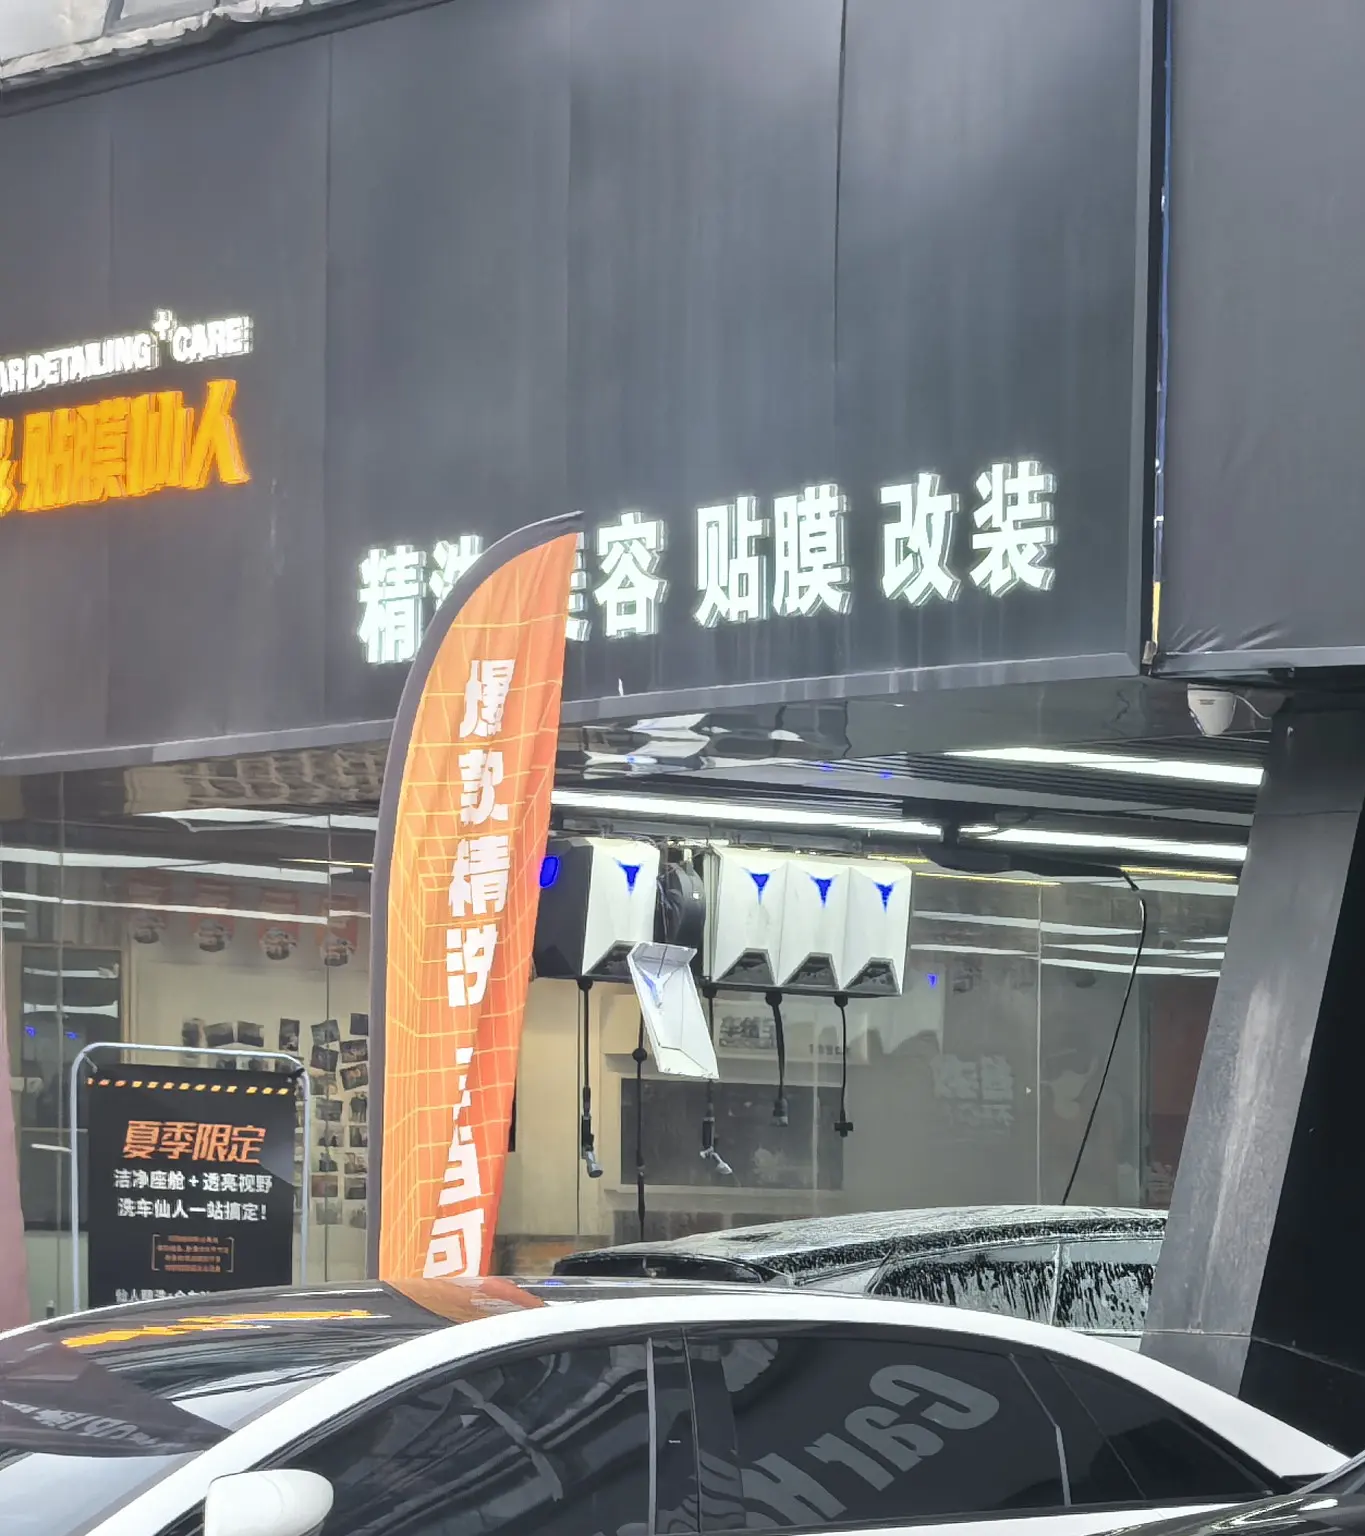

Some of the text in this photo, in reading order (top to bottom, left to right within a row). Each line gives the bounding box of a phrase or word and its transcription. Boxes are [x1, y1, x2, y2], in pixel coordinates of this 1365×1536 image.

[694, 483, 851, 628] 贴膜
[880, 460, 1056, 606] 改装
[122, 1120, 266, 1164] 夏季限定
